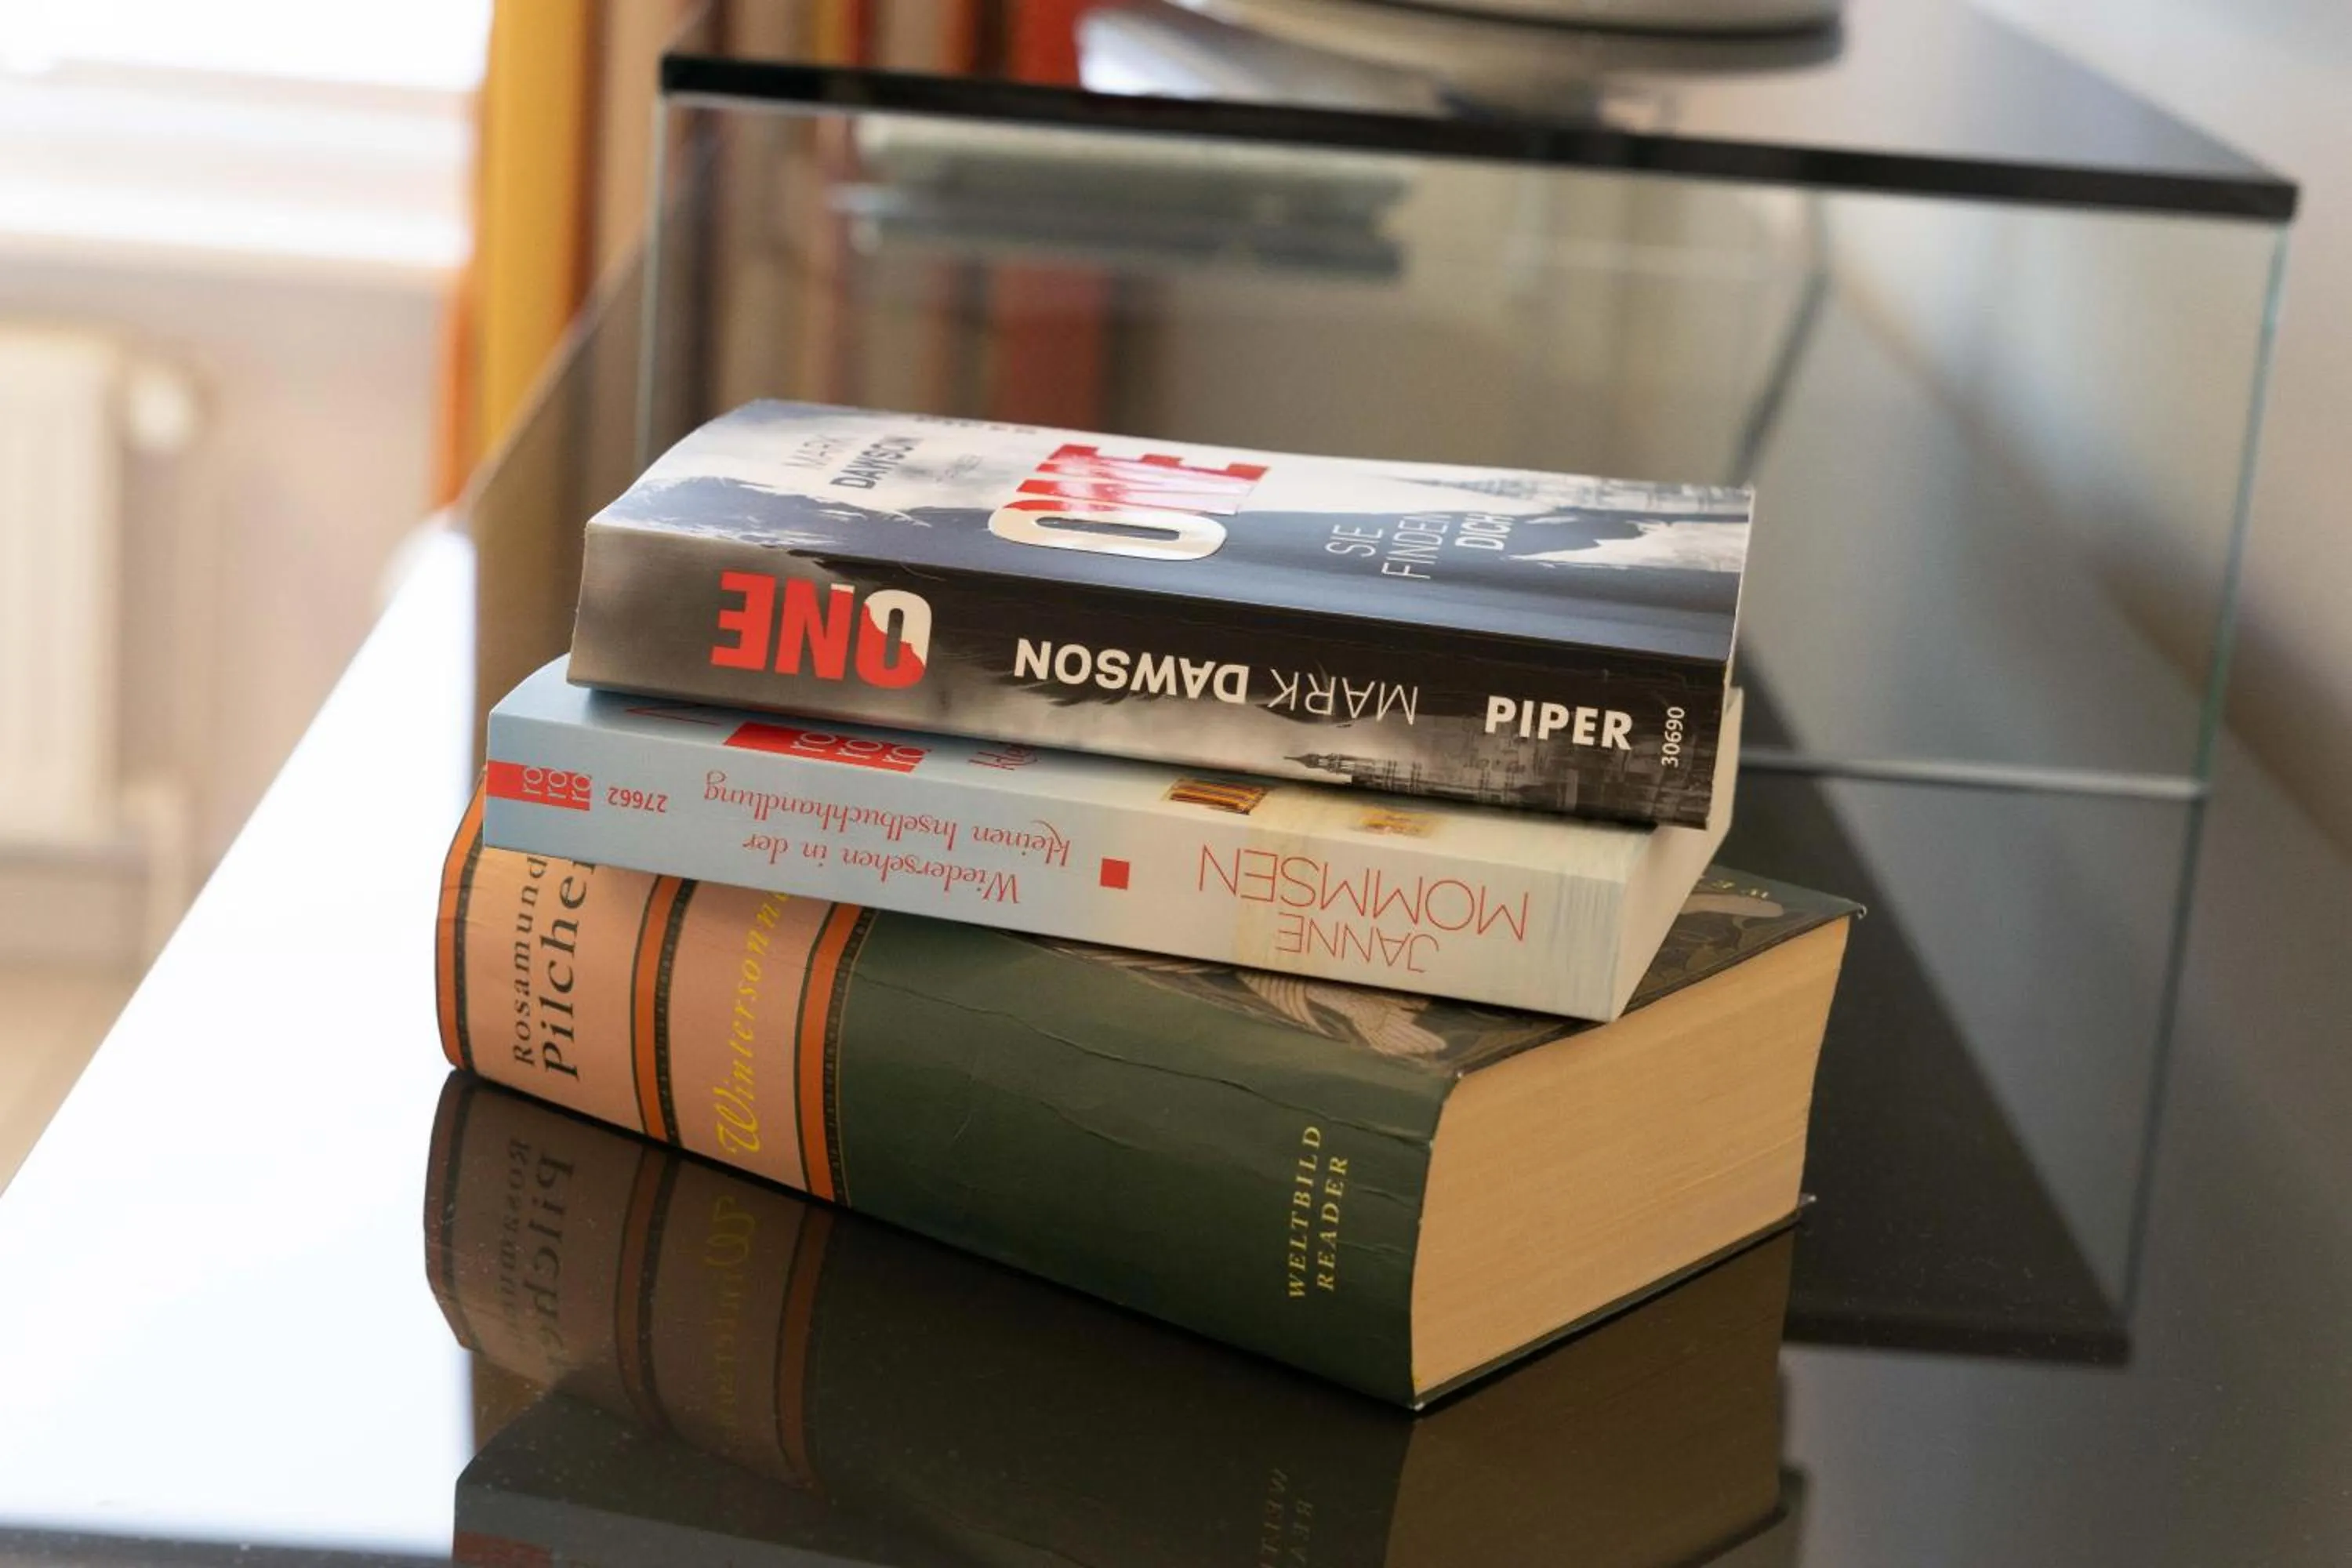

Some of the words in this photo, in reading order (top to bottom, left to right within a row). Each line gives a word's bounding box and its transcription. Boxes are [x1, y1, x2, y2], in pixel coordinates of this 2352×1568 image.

[989, 444, 1270, 561] ONE
[1455, 513, 1515, 550] DICH
[1325, 524, 1383, 557] SIE
[1381, 514, 1452, 579] FINDEN
[711, 569, 932, 688] ONE
[1014, 637, 1249, 704] DAWSON
[1267, 668, 1417, 726] MARK
[1484, 695, 1633, 750] PIPER
[1661, 706, 1685, 768] 30690
[608, 787, 669, 813] 27662
[703, 770, 957, 851] Inselbuchhandlung
[742, 834, 788, 864] der
[801, 842, 828, 868] in
[973, 820, 1072, 866] kleinen
[841, 848, 1020, 905] Wiedersehen
[1198, 844, 1530, 942] MOMMSEN
[1276, 912, 1439, 974] JANNE
[1289, 1126, 1321, 1298] WELTBILD
[1317, 1156, 1348, 1290] READER
